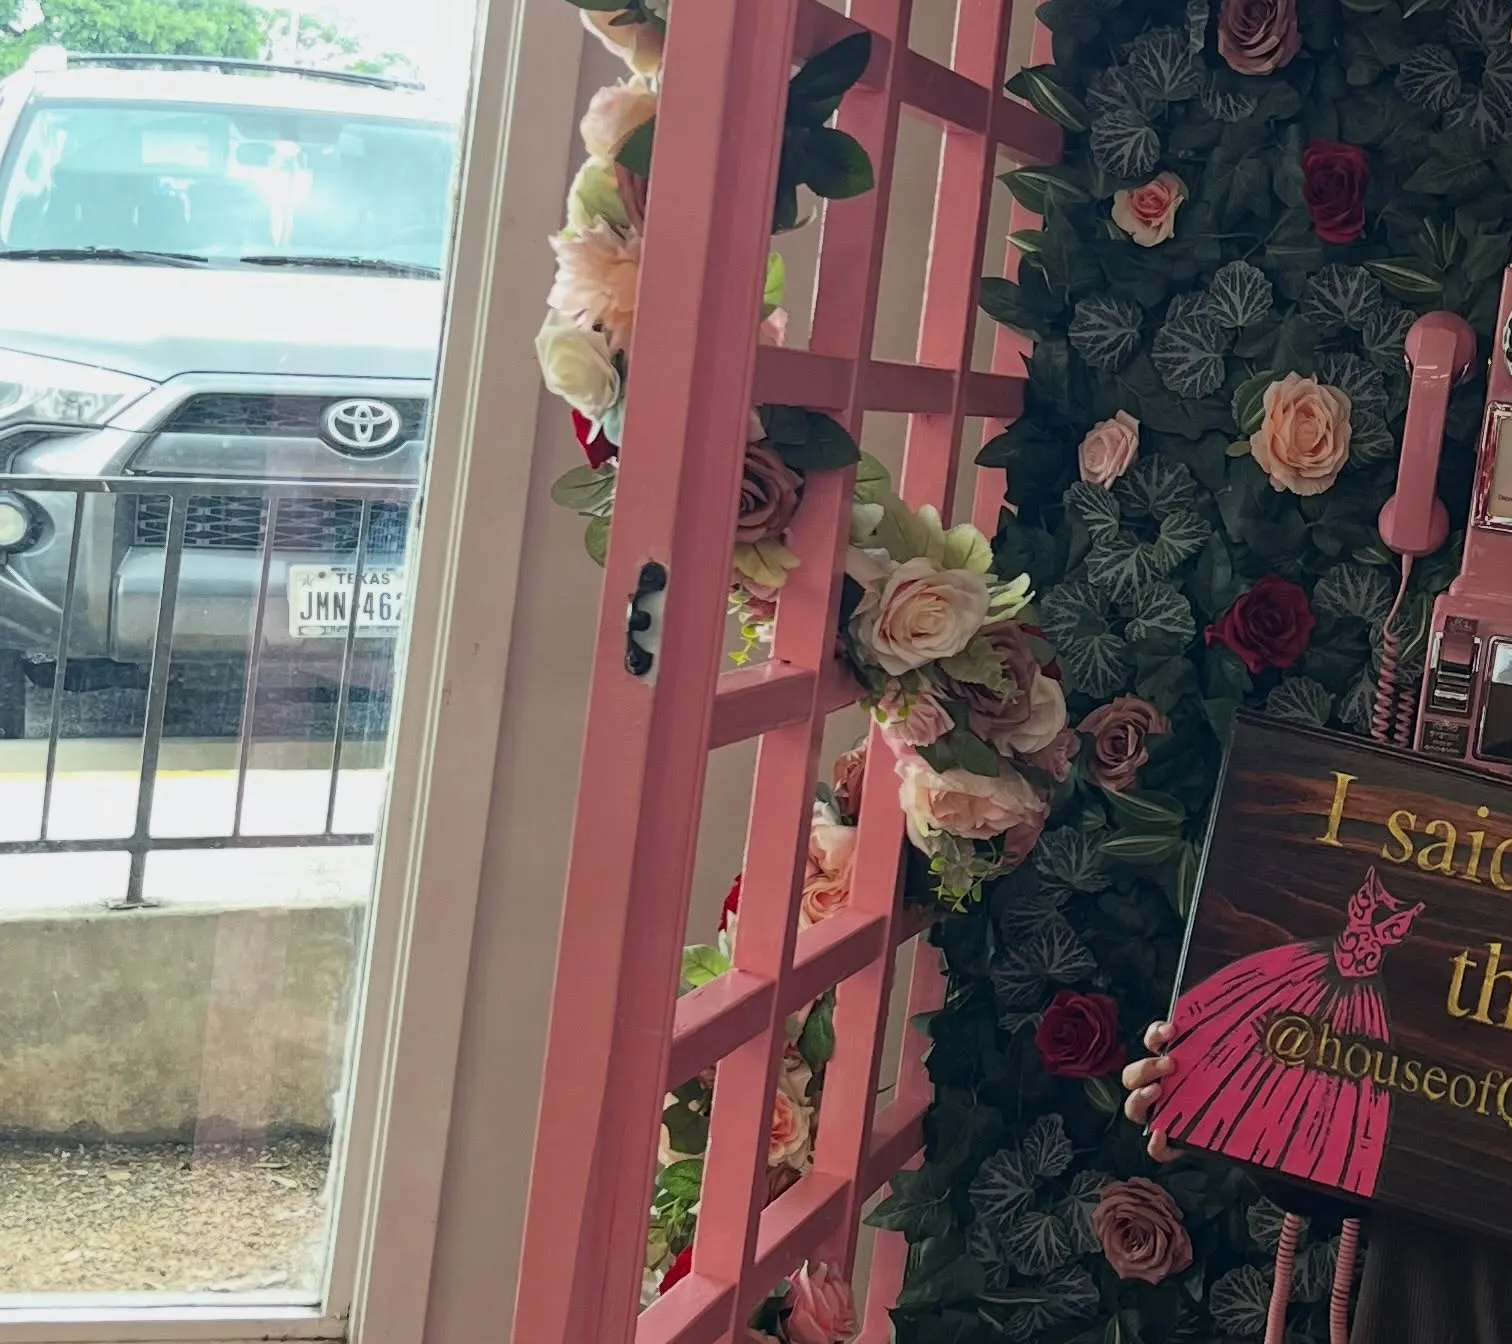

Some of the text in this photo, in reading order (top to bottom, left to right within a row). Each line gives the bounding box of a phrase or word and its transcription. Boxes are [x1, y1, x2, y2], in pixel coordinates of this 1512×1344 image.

[336, 572, 391, 585] TEXAS
[300, 591, 346, 621] JMN
[1315, 771, 1359, 847] I
